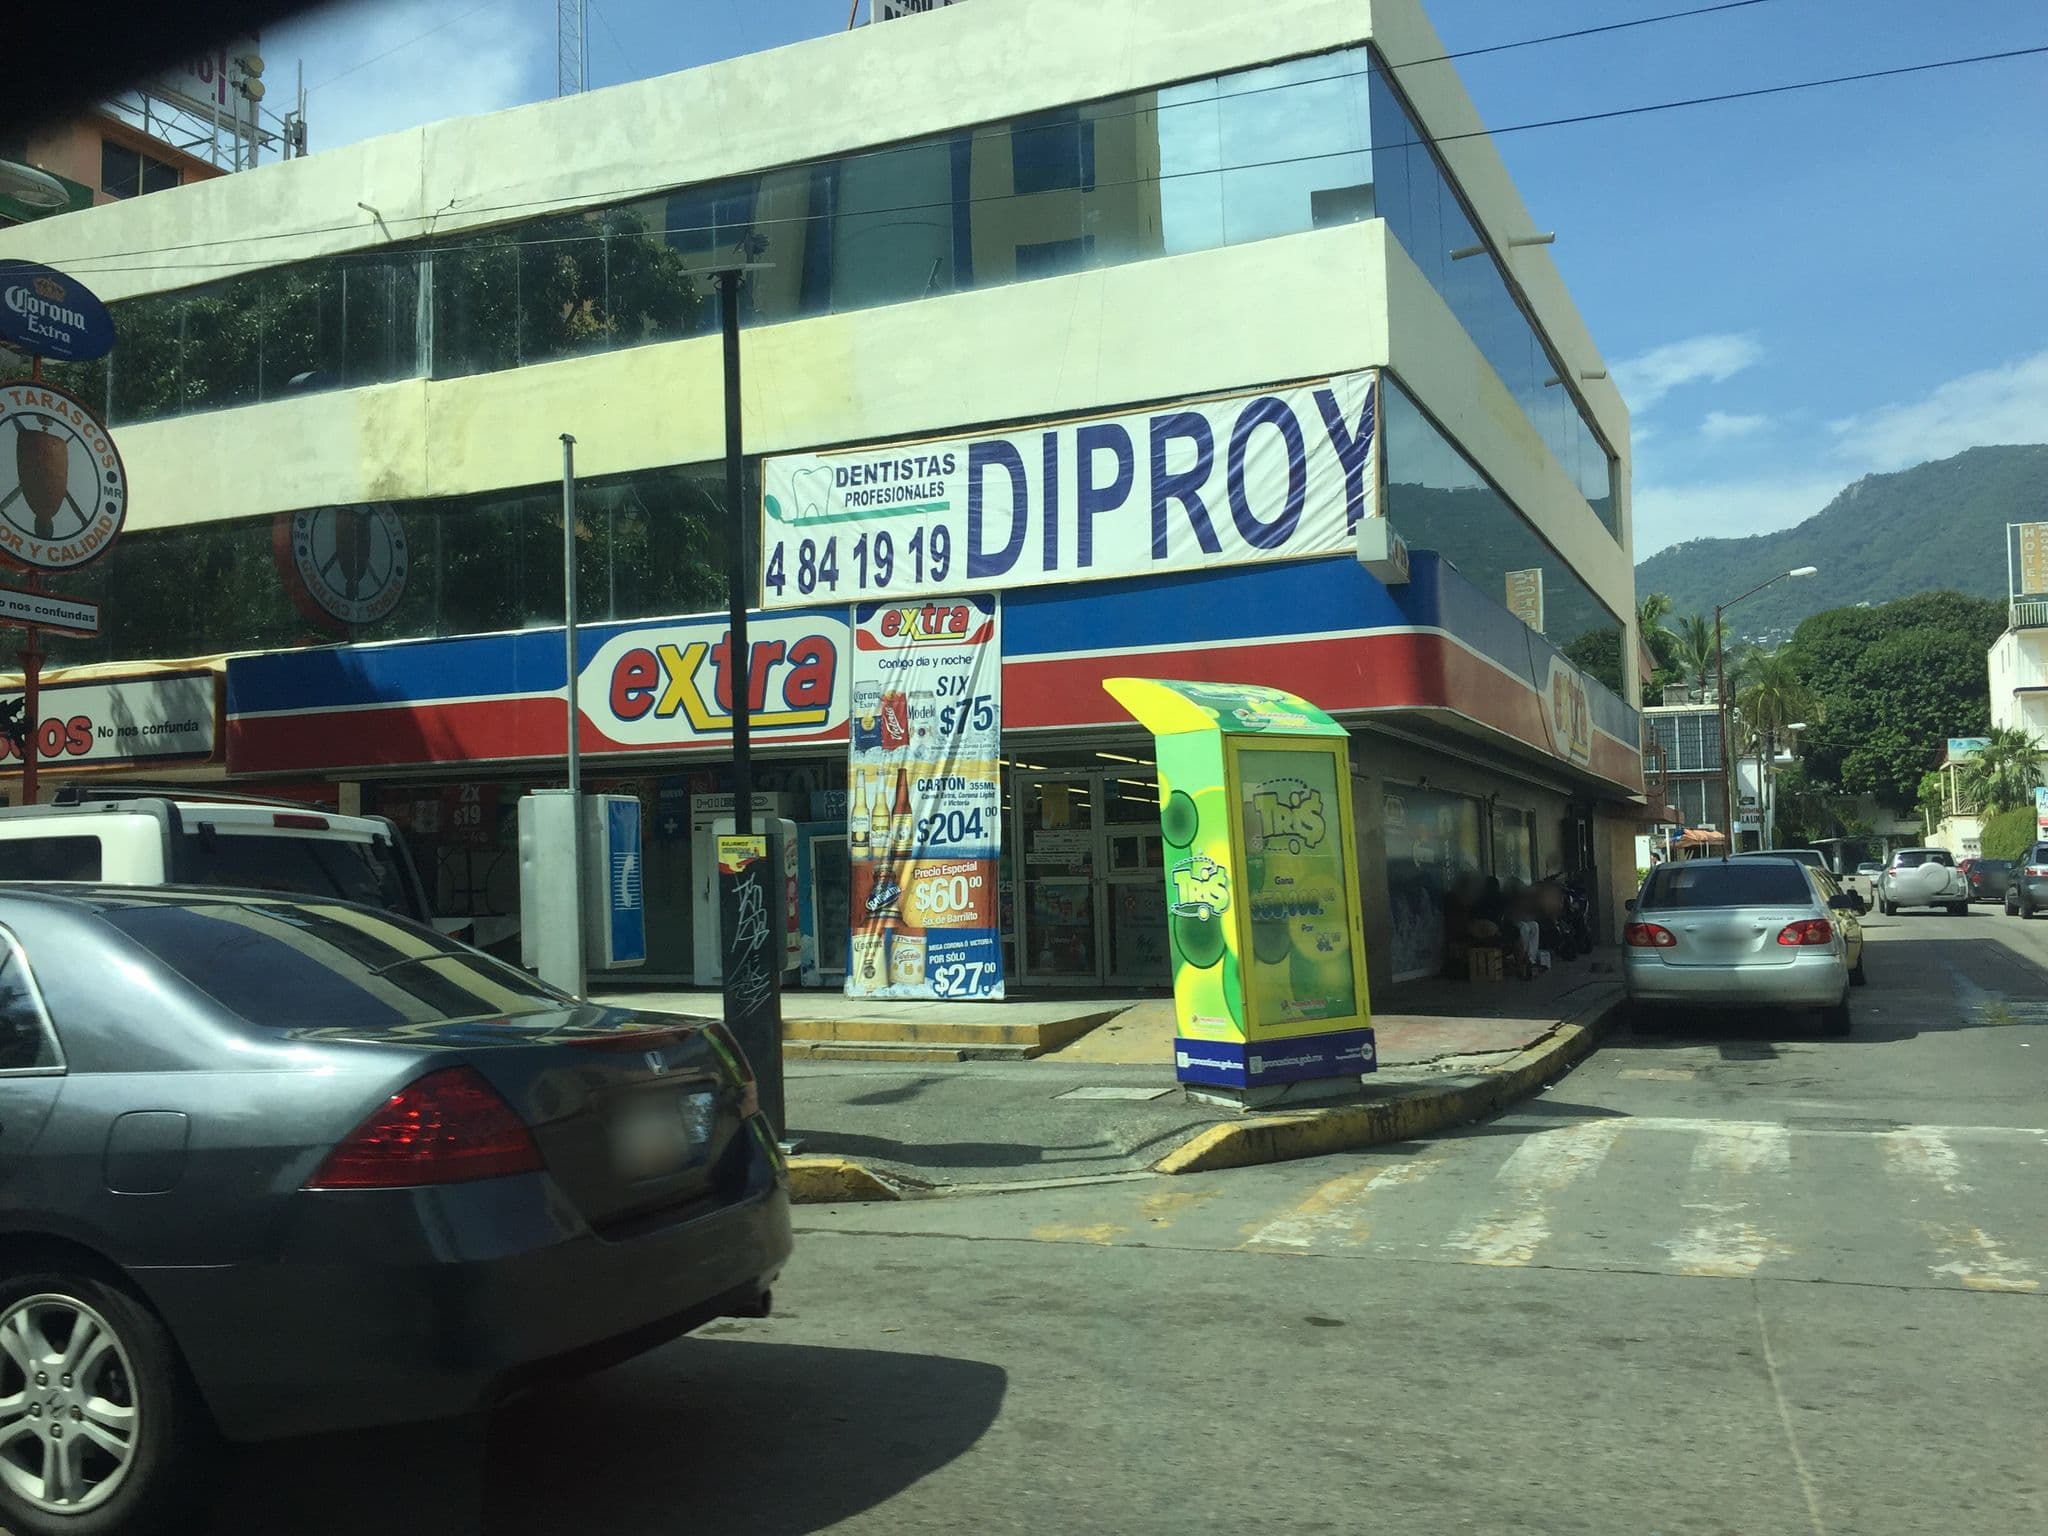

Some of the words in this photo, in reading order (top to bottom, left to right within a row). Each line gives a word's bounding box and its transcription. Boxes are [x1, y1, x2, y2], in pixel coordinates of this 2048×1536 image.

[5, 285, 86, 330] Corona
[28, 313, 71, 344] Extra
[9, 390, 115, 468] TARASCOS
[836, 453, 956, 487] DENTISTAS
[966, 381, 1376, 579] DIPROY
[103, 486, 122, 499] MR
[48, 515, 113, 563] CALIDAD
[766, 541, 786, 596] 4
[798, 536, 839, 594] 84
[853, 531, 894, 589] 19
[909, 524, 951, 583] 19
[9, 601, 31, 612] nos
[35, 605, 95, 623] confundas
[881, 603, 969, 641] extra
[941, 655, 972, 666] noche
[609, 631, 837, 734] extra
[936, 675, 970, 697] SIX
[98, 726, 114, 738] No
[118, 724, 138, 736] nos
[143, 720, 199, 735] confunda
[939, 695, 993, 737] $75
[917, 774, 966, 792] CARTÓN
[970, 782, 996, 791] 355ML
[914, 866, 941, 879] Precio
[942, 861, 977, 876] Especial
[929, 954, 944, 964] POR
[945, 951, 966, 962] SÓLO
